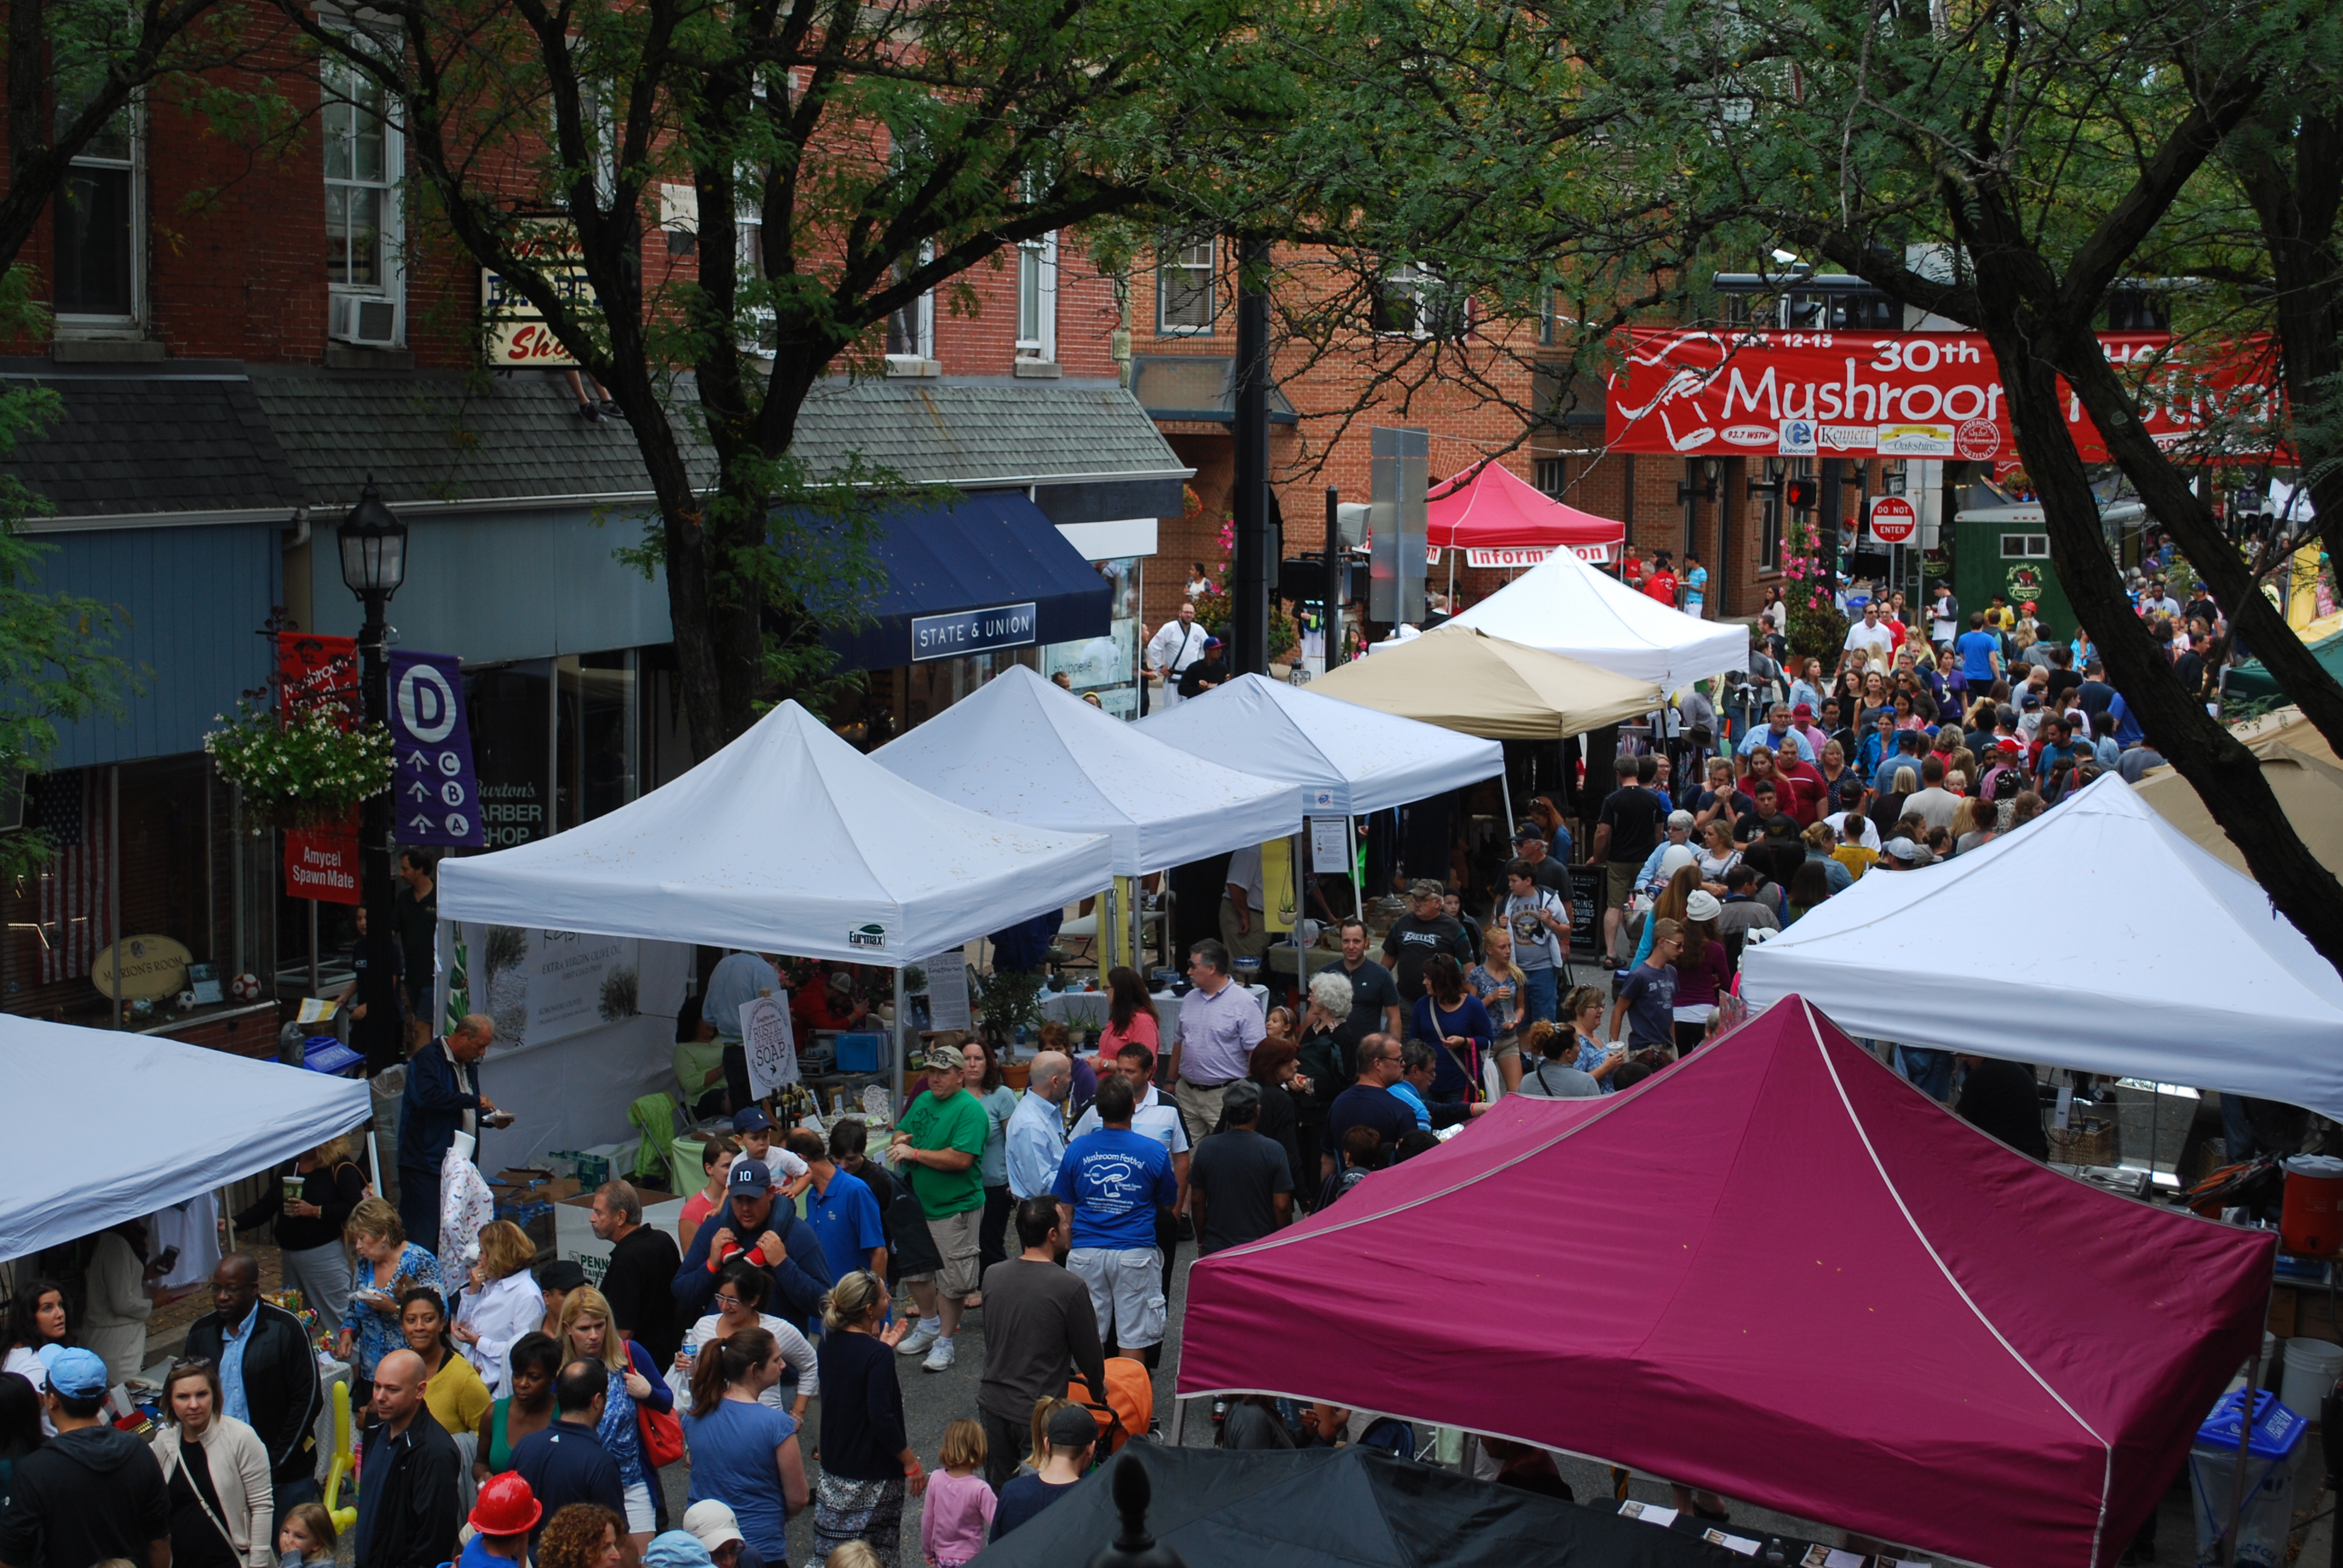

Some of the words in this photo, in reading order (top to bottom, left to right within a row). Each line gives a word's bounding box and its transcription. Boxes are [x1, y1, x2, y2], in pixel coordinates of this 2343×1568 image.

[508, 325, 573, 360] Sho
[1781, 333, 1832, 348] 12-13
[1870, 339, 1980, 373] 30th
[1821, 426, 1875, 446] Kennett
[1894, 440, 1936, 452] Oakshire
[1961, 445, 1996, 459] INSTITUTE
[1893, 506, 1909, 514] NOT
[1880, 526, 1906, 534] ENTER
[1472, 546, 1603, 565] Informaon
[920, 624, 965, 647] STATE
[971, 622, 979, 638] &
[986, 615, 1029, 637] UNION
[412, 676, 446, 729] D
[442, 756, 456, 773] C
[447, 785, 460, 802] B
[479, 804, 542, 822] ARBER
[452, 818, 464, 832] A
[304, 846, 341, 868] Amycel
[293, 864, 326, 886] Spawn
[327, 869, 354, 889] Mate
[1573, 899, 1593, 909] THING
[849, 930, 883, 946] Eurmax
[1403, 932, 1435, 945] EAGLES
[542, 960, 563, 975] EXTRA
[565, 952, 589, 968] VIRGIN
[590, 947, 609, 961] OLIVE
[611, 944, 622, 956] OIL
[928, 958, 949, 967] OLIVE
[103, 962, 152, 982] MRION'S
[154, 956, 185, 971] ROOM
[753, 1018, 782, 1041] RUSTIC
[755, 1035, 773, 1050] OLIVE
[773, 1031, 784, 1043] OIL
[756, 1041, 785, 1067] SOAP
[1083, 1151, 1119, 1166] Mushroom
[1119, 1153, 1145, 1169] Festival
[739, 1170, 752, 1181] 10
[583, 1268, 605, 1279] TAINE
